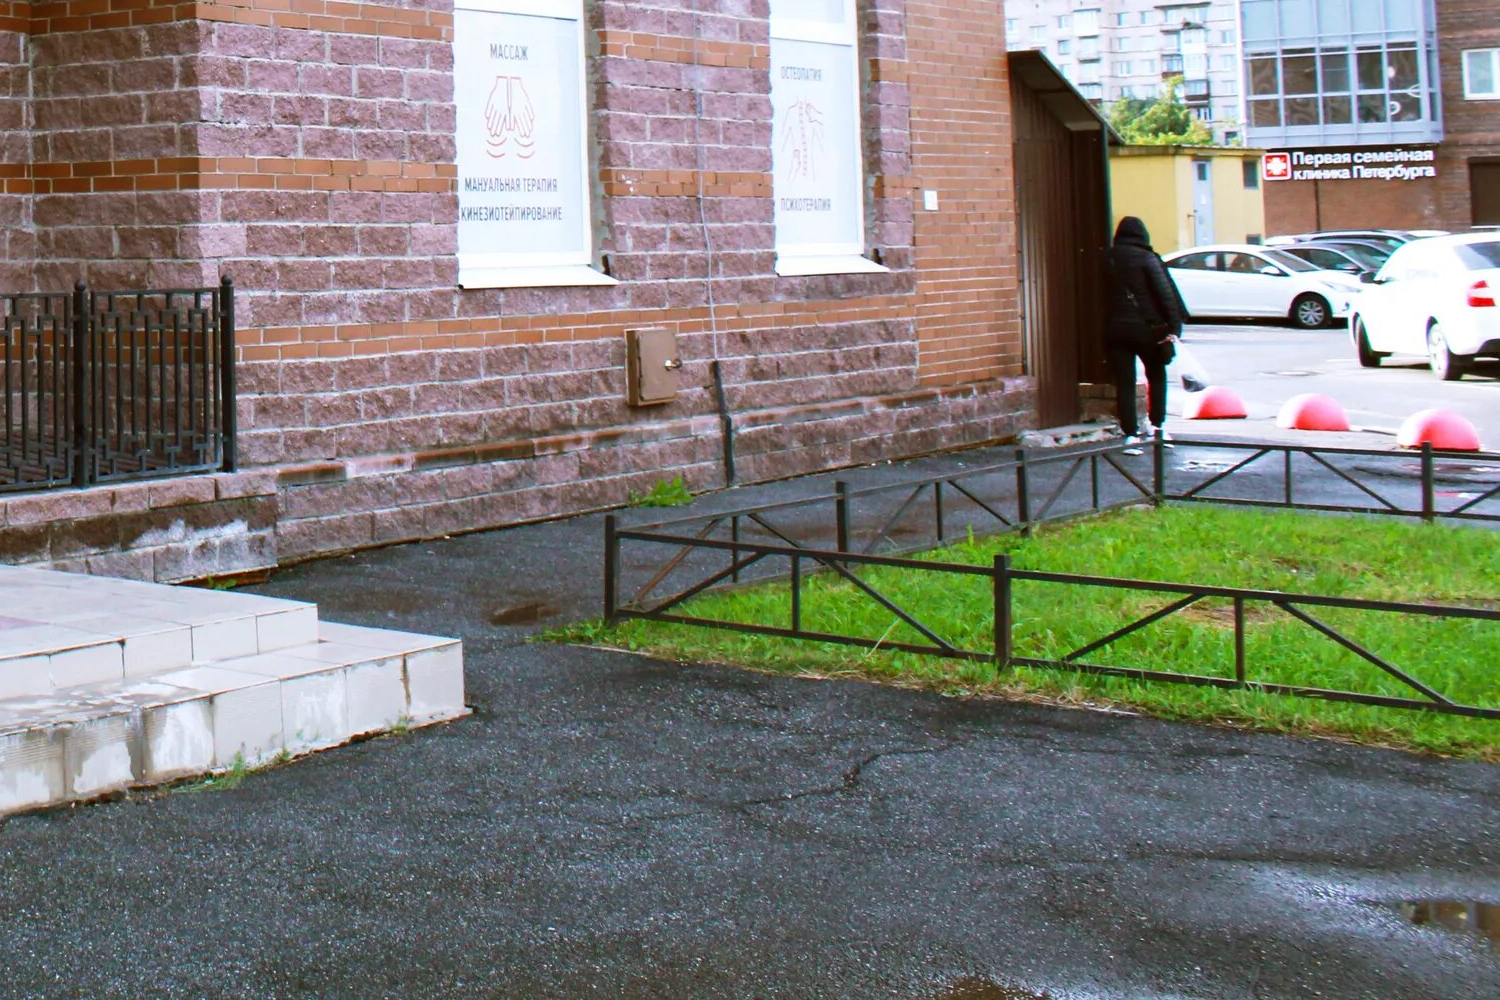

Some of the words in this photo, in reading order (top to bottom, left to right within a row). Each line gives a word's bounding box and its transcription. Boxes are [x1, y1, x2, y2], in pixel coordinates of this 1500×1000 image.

[490, 43, 529, 61] МАССАЖ
[1292, 151, 1351, 168] Первая
[1352, 149, 1434, 164] семейная
[1293, 166, 1351, 180] клиника
[1352, 165, 1436, 180] Петербурга
[464, 177, 521, 192] МАНУАЛЬНАЯ
[523, 178, 558, 192] ТЕРАПИЯ
[460, 203, 563, 222] КИНЕЗИОТЕЙПИРОВАНИЕ
